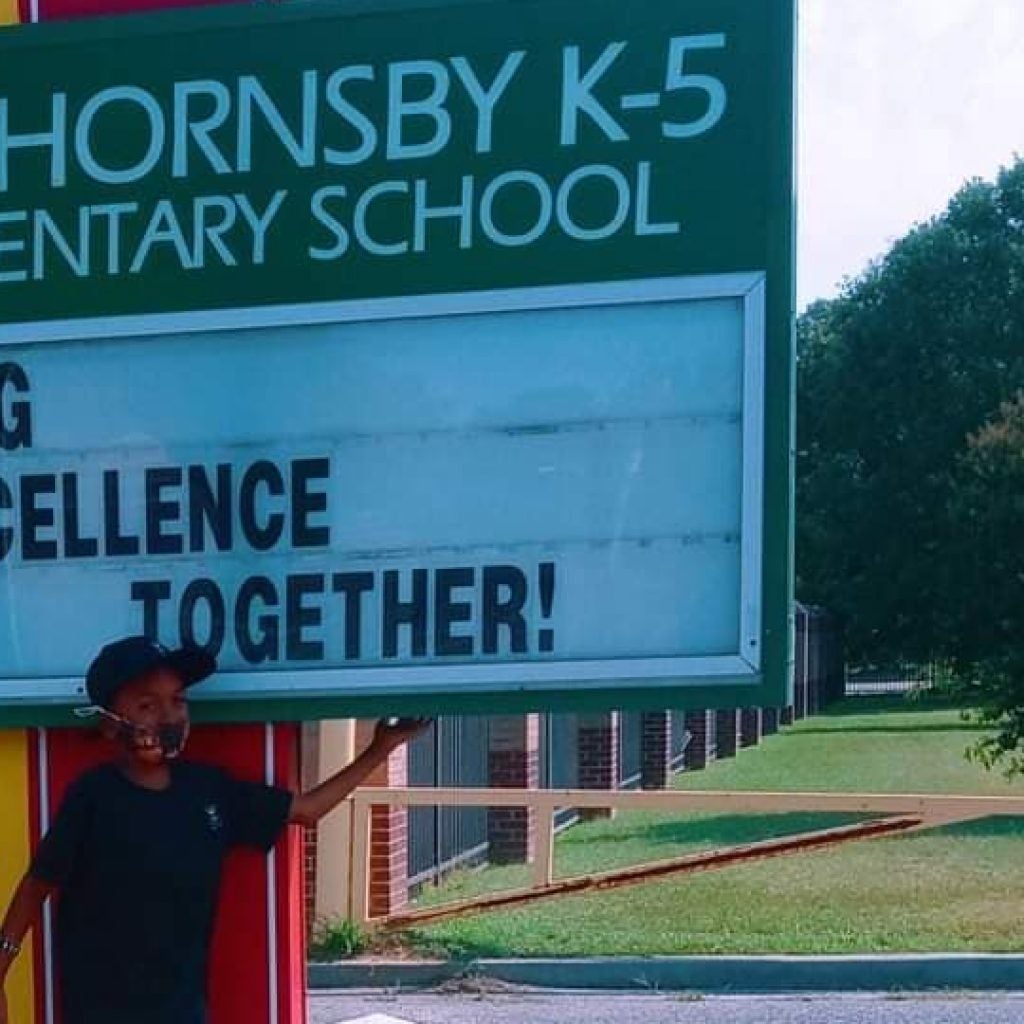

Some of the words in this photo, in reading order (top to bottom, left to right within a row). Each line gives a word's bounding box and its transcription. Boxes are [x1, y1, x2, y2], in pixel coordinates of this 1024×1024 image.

[559, 33, 728, 146] K-5
[308, 160, 680, 261] SCHOOL
[131, 562, 555, 664] TOGETHER!
